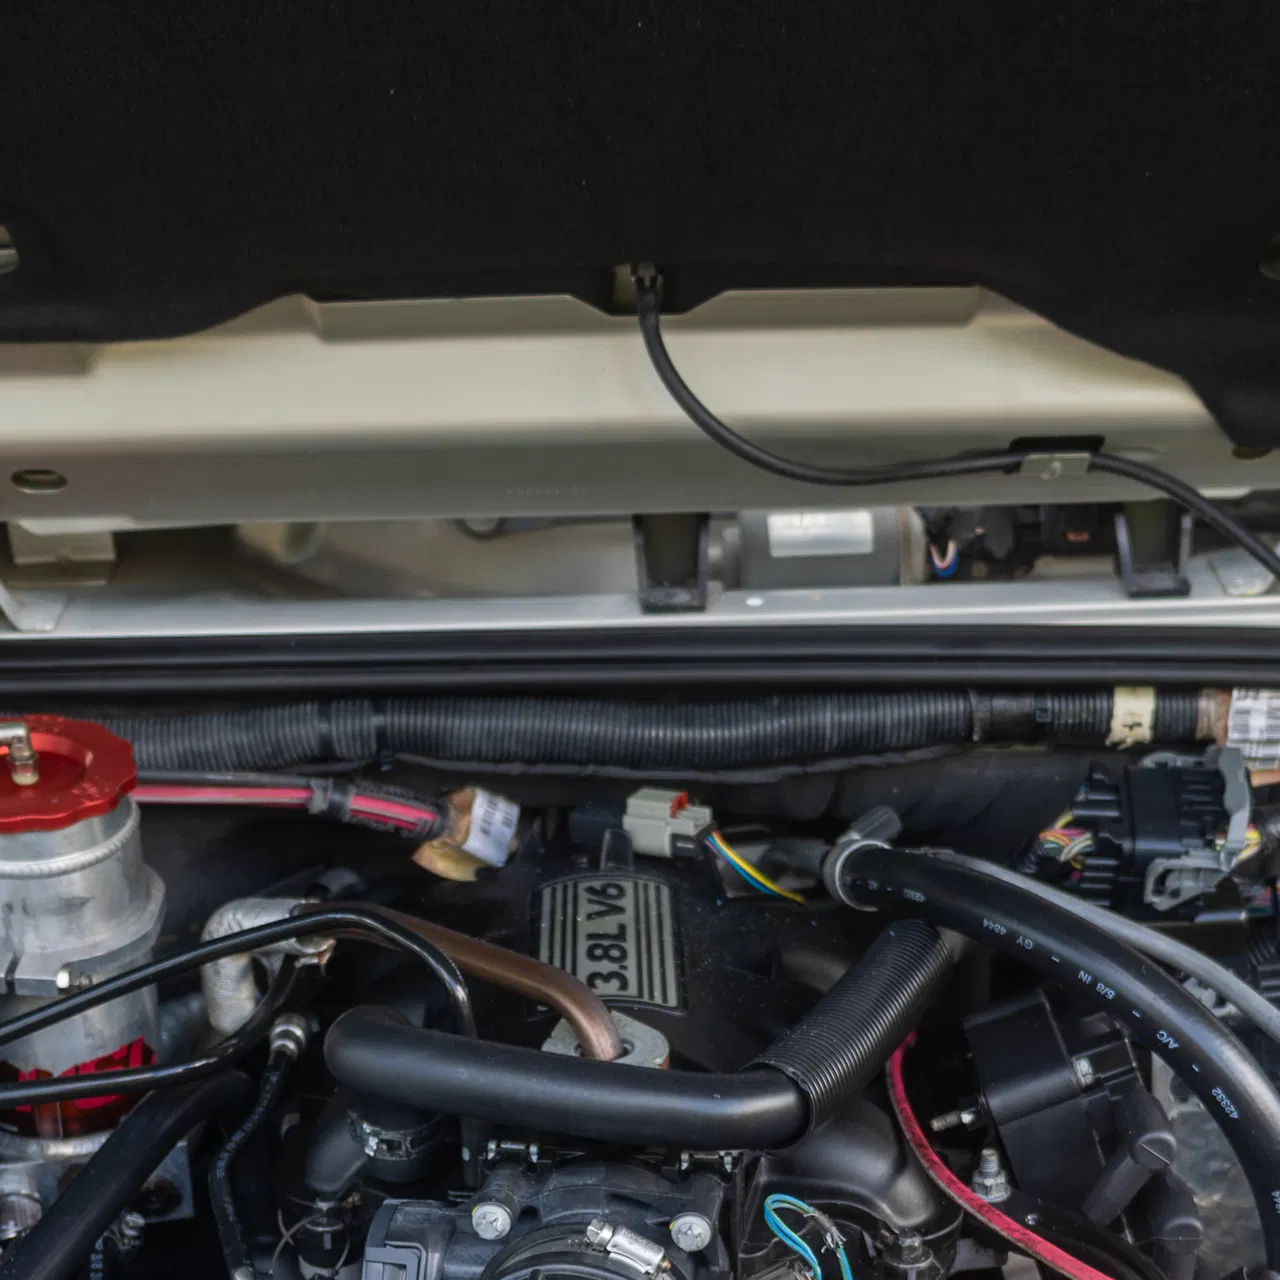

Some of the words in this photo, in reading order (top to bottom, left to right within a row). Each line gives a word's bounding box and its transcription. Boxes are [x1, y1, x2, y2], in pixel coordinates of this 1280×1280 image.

[583, 882, 626, 921] V6
[982, 918, 1007, 936] 4844
[1016, 936, 1034, 950] GY
[586, 923, 629, 992] 3.8L
[1077, 970, 1092, 985] IN
[1095, 983, 1116, 1000] 5/8
[1211, 1087, 1239, 1119] 42332
